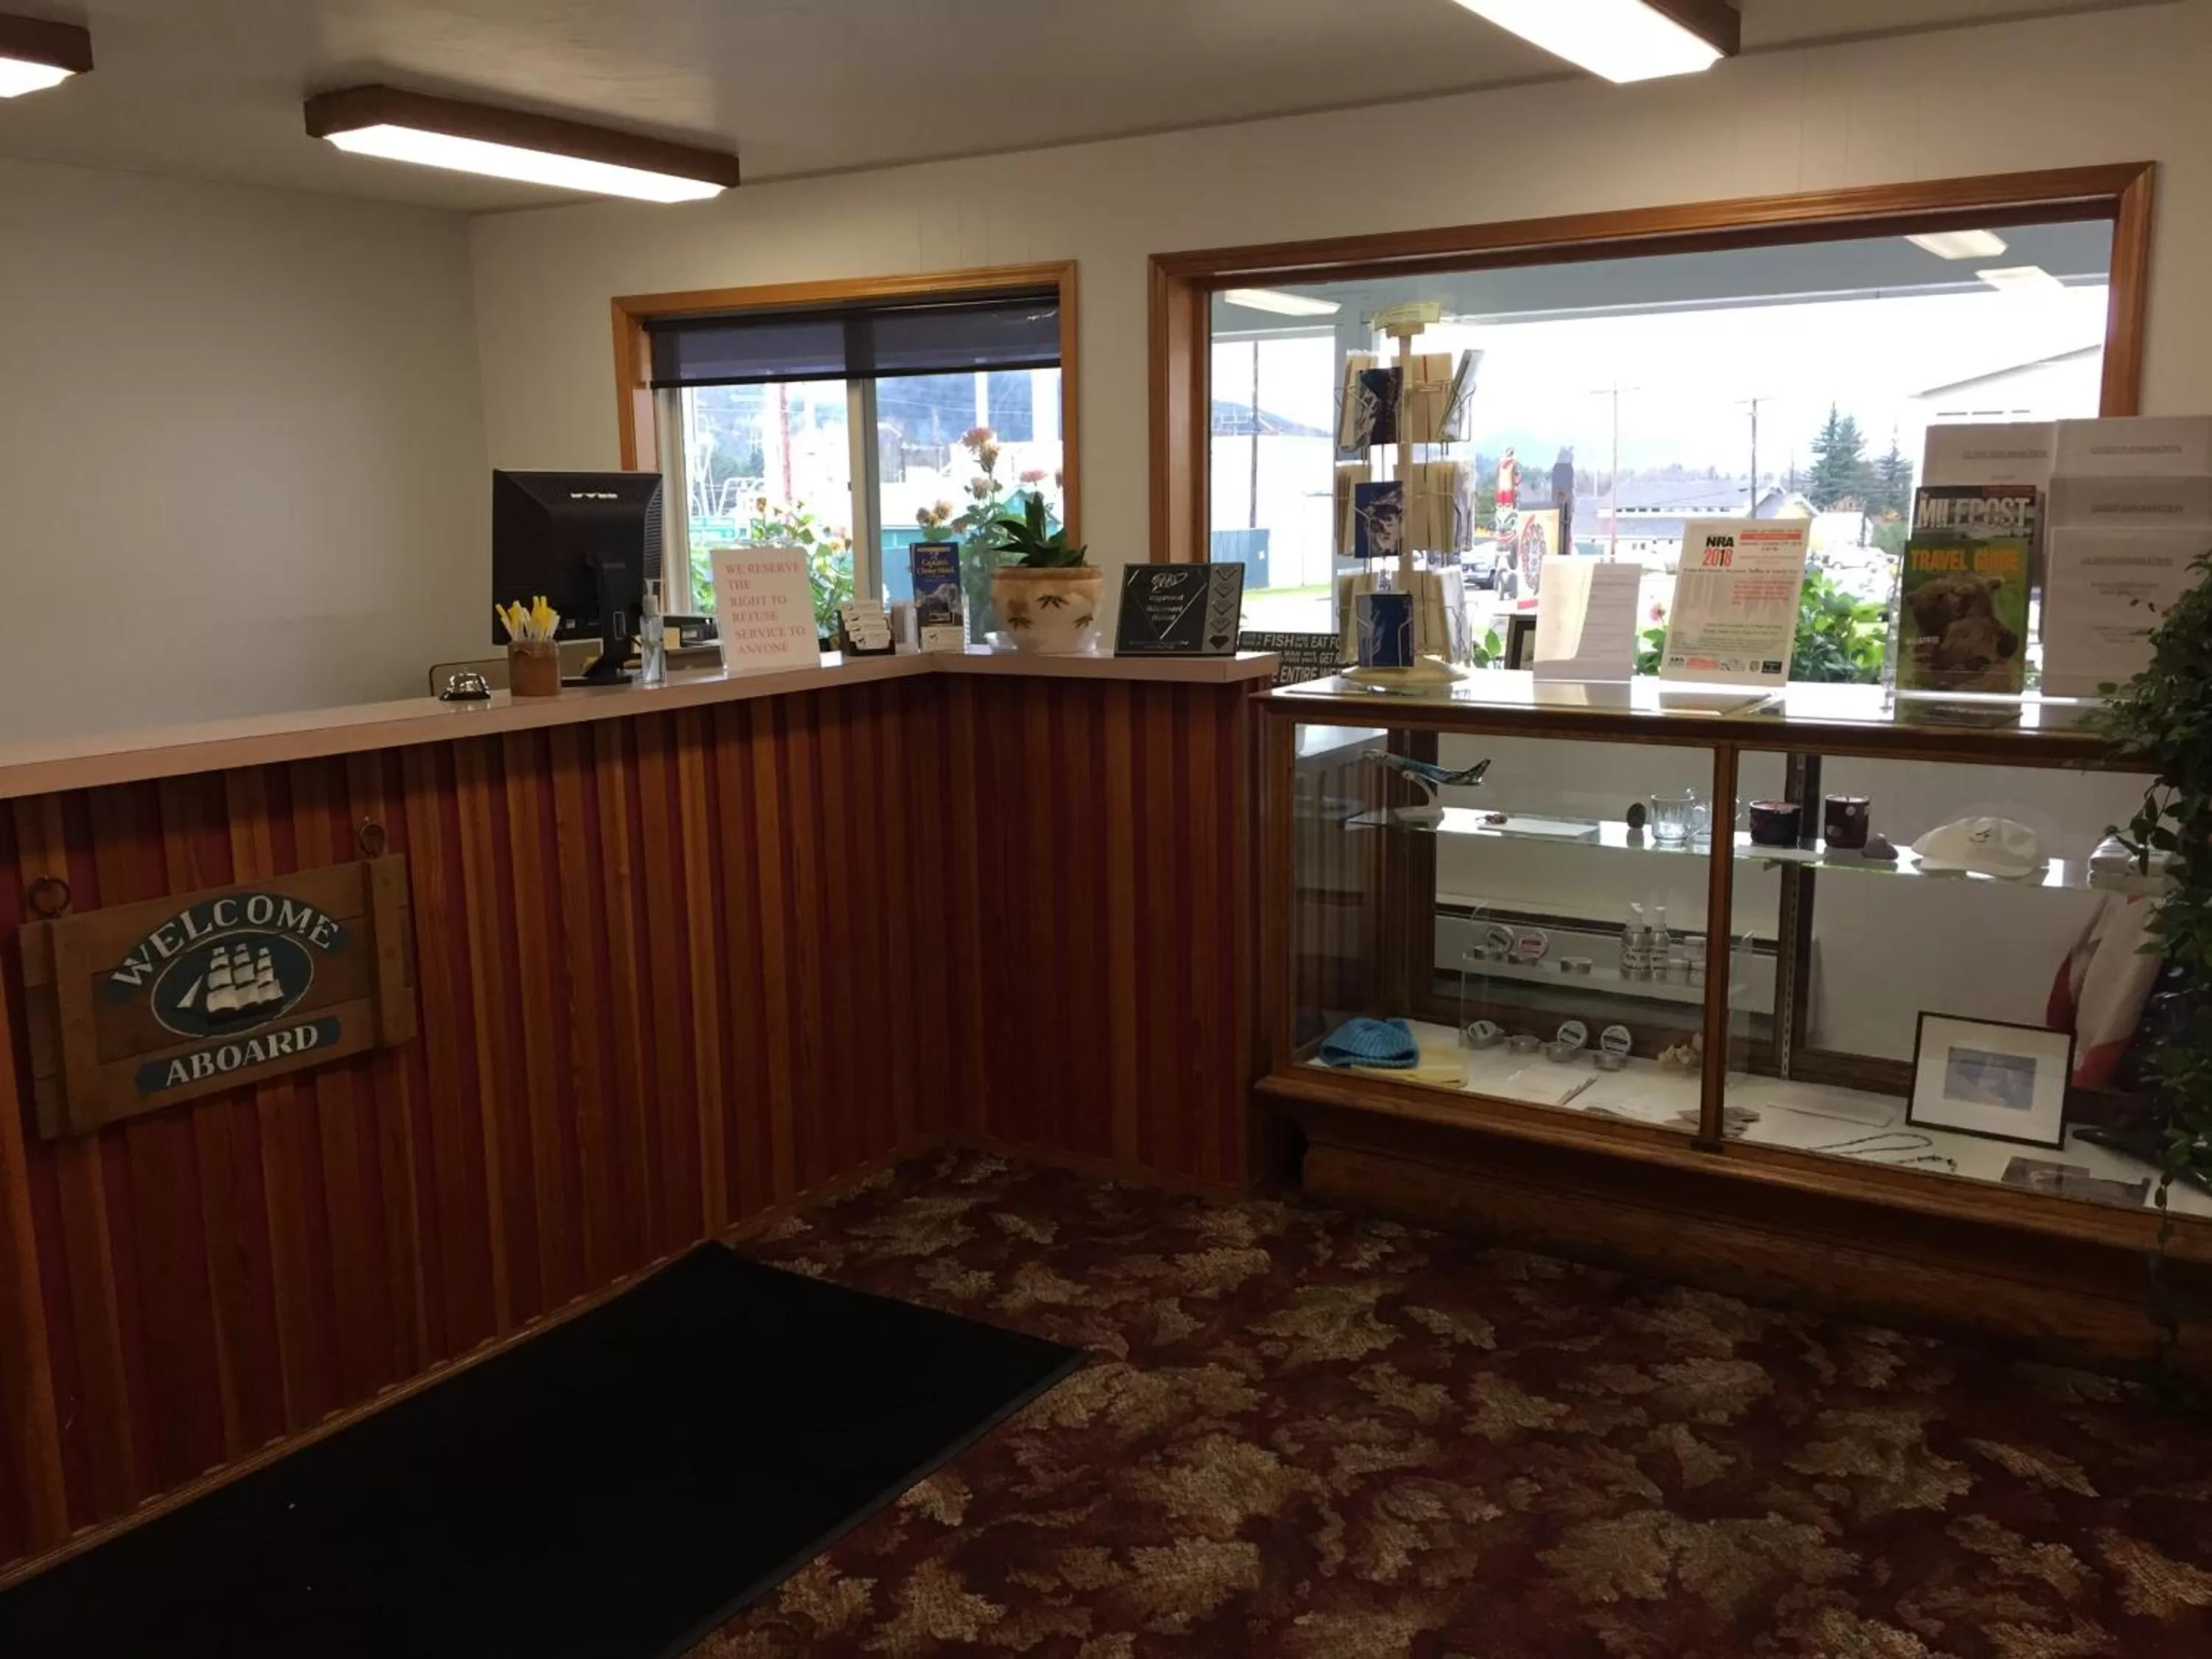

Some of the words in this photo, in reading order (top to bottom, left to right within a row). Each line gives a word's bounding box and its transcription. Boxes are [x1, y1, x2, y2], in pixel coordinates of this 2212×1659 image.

[1917, 497, 2030, 529] MILEPOST
[1705, 536, 1734, 547] NRA
[1702, 548, 1733, 567] 2018
[1910, 549, 1968, 571] TRAVEL
[1975, 549, 2019, 571] GUIDE
[723, 563, 744, 574] WE
[747, 563, 799, 574] RESERVE
[728, 579, 750, 591] THE
[730, 595, 766, 607] RIGHT
[771, 594, 787, 605] TO
[732, 611, 778, 623] REFUSE
[734, 627, 786, 639] SERVICE
[789, 625, 806, 636] TO
[1263, 633, 1294, 648] FISH
[1310, 636, 1327, 648] EAT
[738, 642, 790, 654] ANYONE
[1279, 666, 1318, 683] ENTIRE
[111, 894, 340, 987] WELCOME
[166, 1025, 319, 1087] ABOARD
